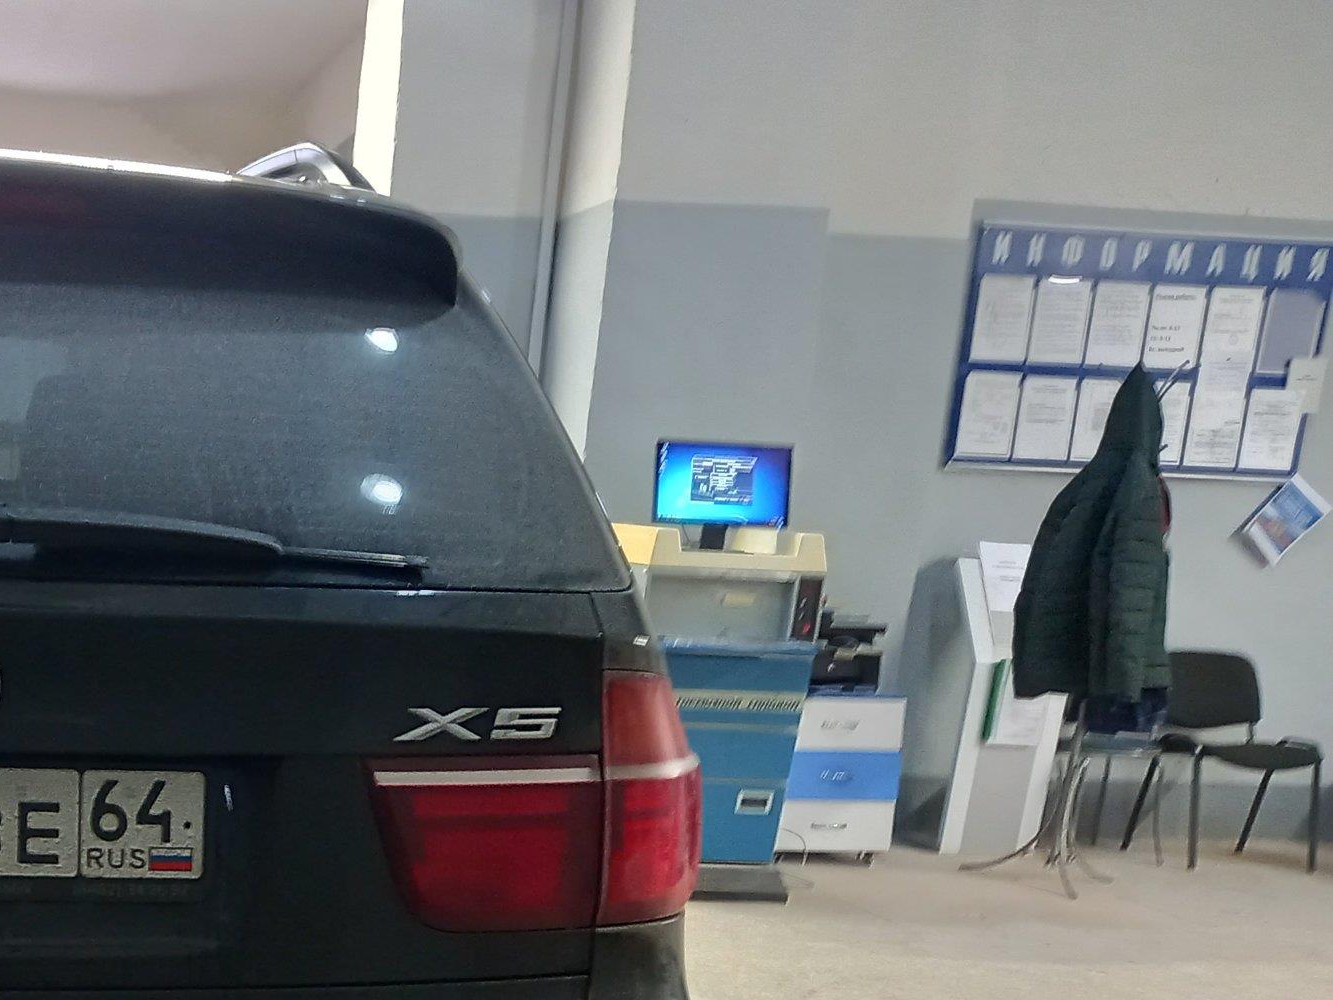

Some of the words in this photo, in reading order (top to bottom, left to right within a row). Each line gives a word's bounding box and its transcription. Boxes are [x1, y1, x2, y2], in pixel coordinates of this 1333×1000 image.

[991, 230, 1330, 283] ИНФОРМАЦИЯ
[393, 707, 562, 741] X5
[91, 780, 171, 843] 64
[87, 847, 146, 869] RUS
